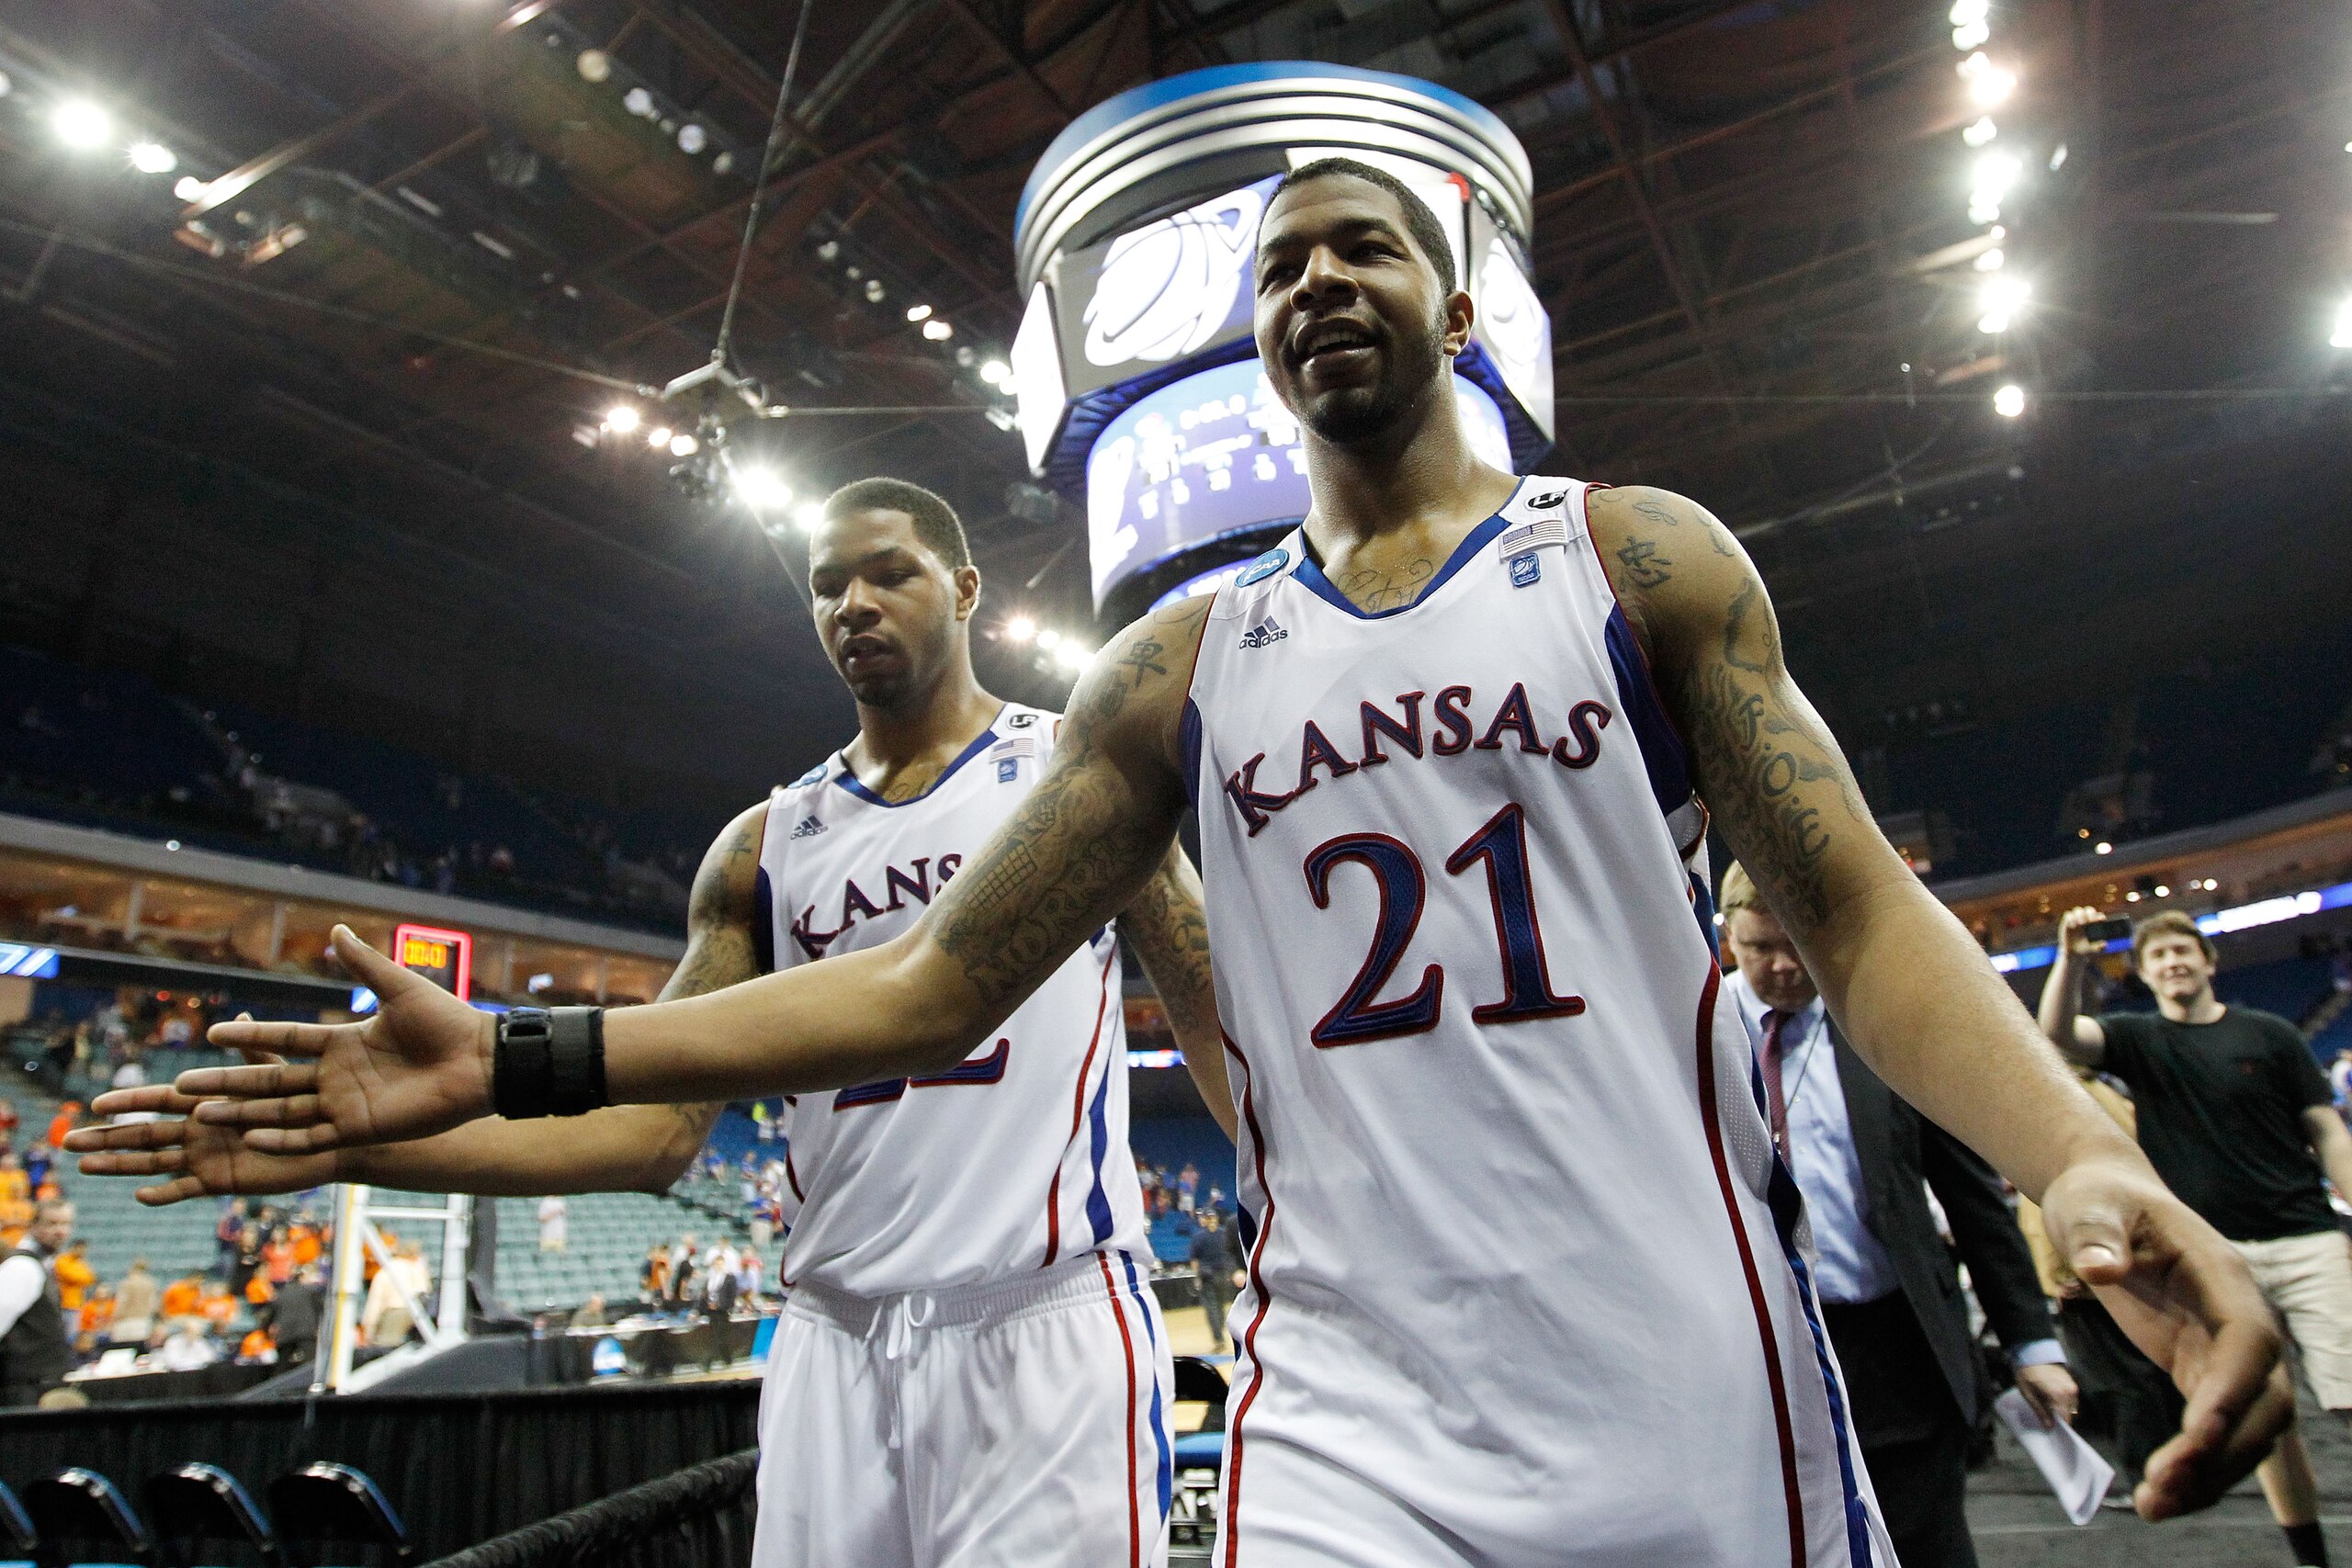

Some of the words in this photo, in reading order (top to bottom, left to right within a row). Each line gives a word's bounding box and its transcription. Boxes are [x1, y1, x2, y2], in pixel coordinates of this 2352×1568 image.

[1242, 558, 1281, 583] NCAA
[1238, 628, 1289, 649] adidas
[1225, 682, 1612, 837] KANSAS
[790, 826, 829, 840] adidas
[1303, 802, 1587, 1049] 21
